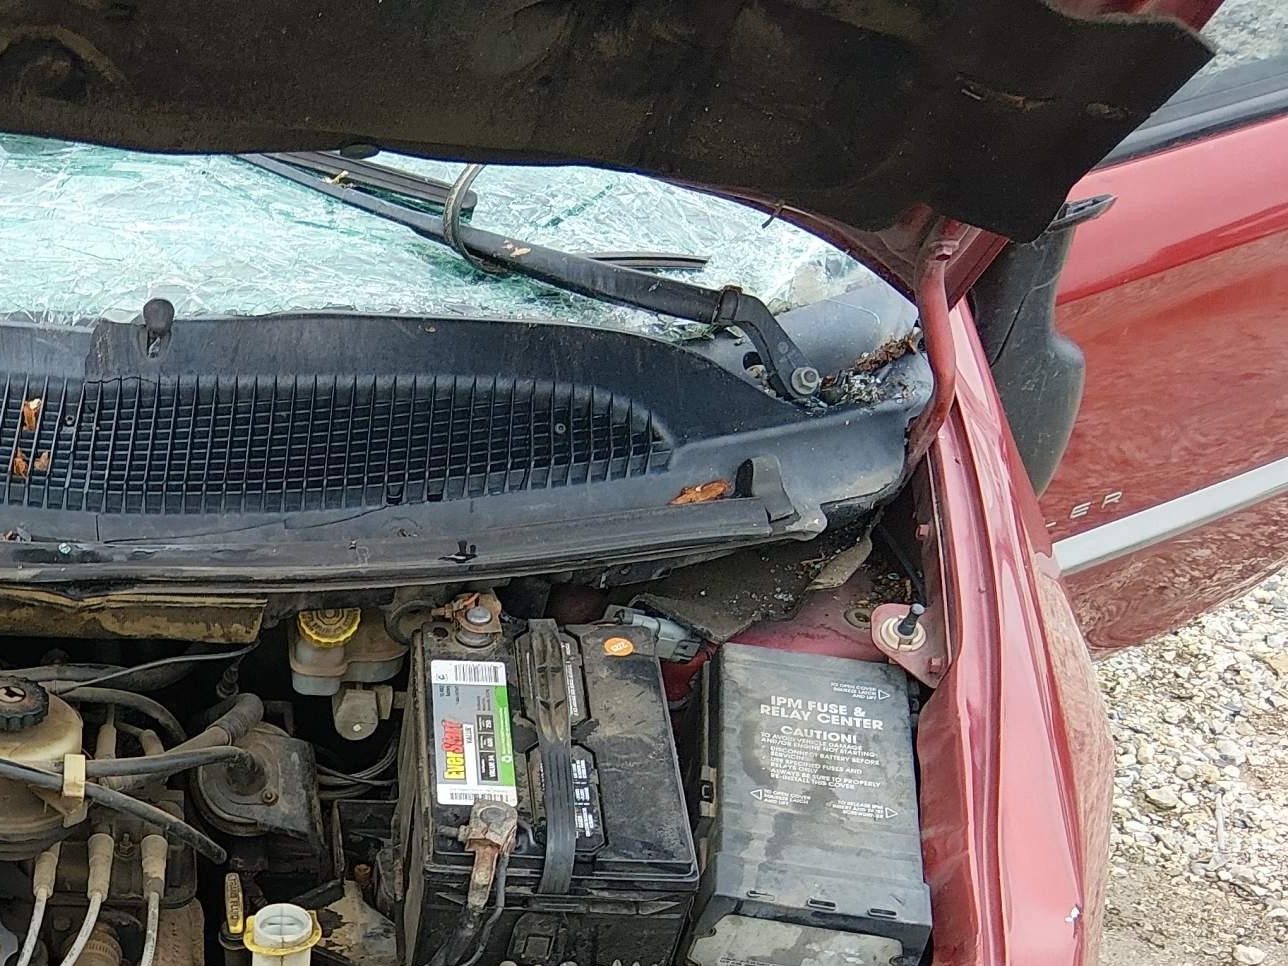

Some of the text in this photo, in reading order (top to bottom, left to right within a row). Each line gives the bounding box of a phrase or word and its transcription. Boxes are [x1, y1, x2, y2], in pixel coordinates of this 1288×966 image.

[760, 704, 883, 730] RELAY CENTER
[770, 695, 865, 717] IPM FUSE &
[780, 725, 858, 744] CAUTION!
